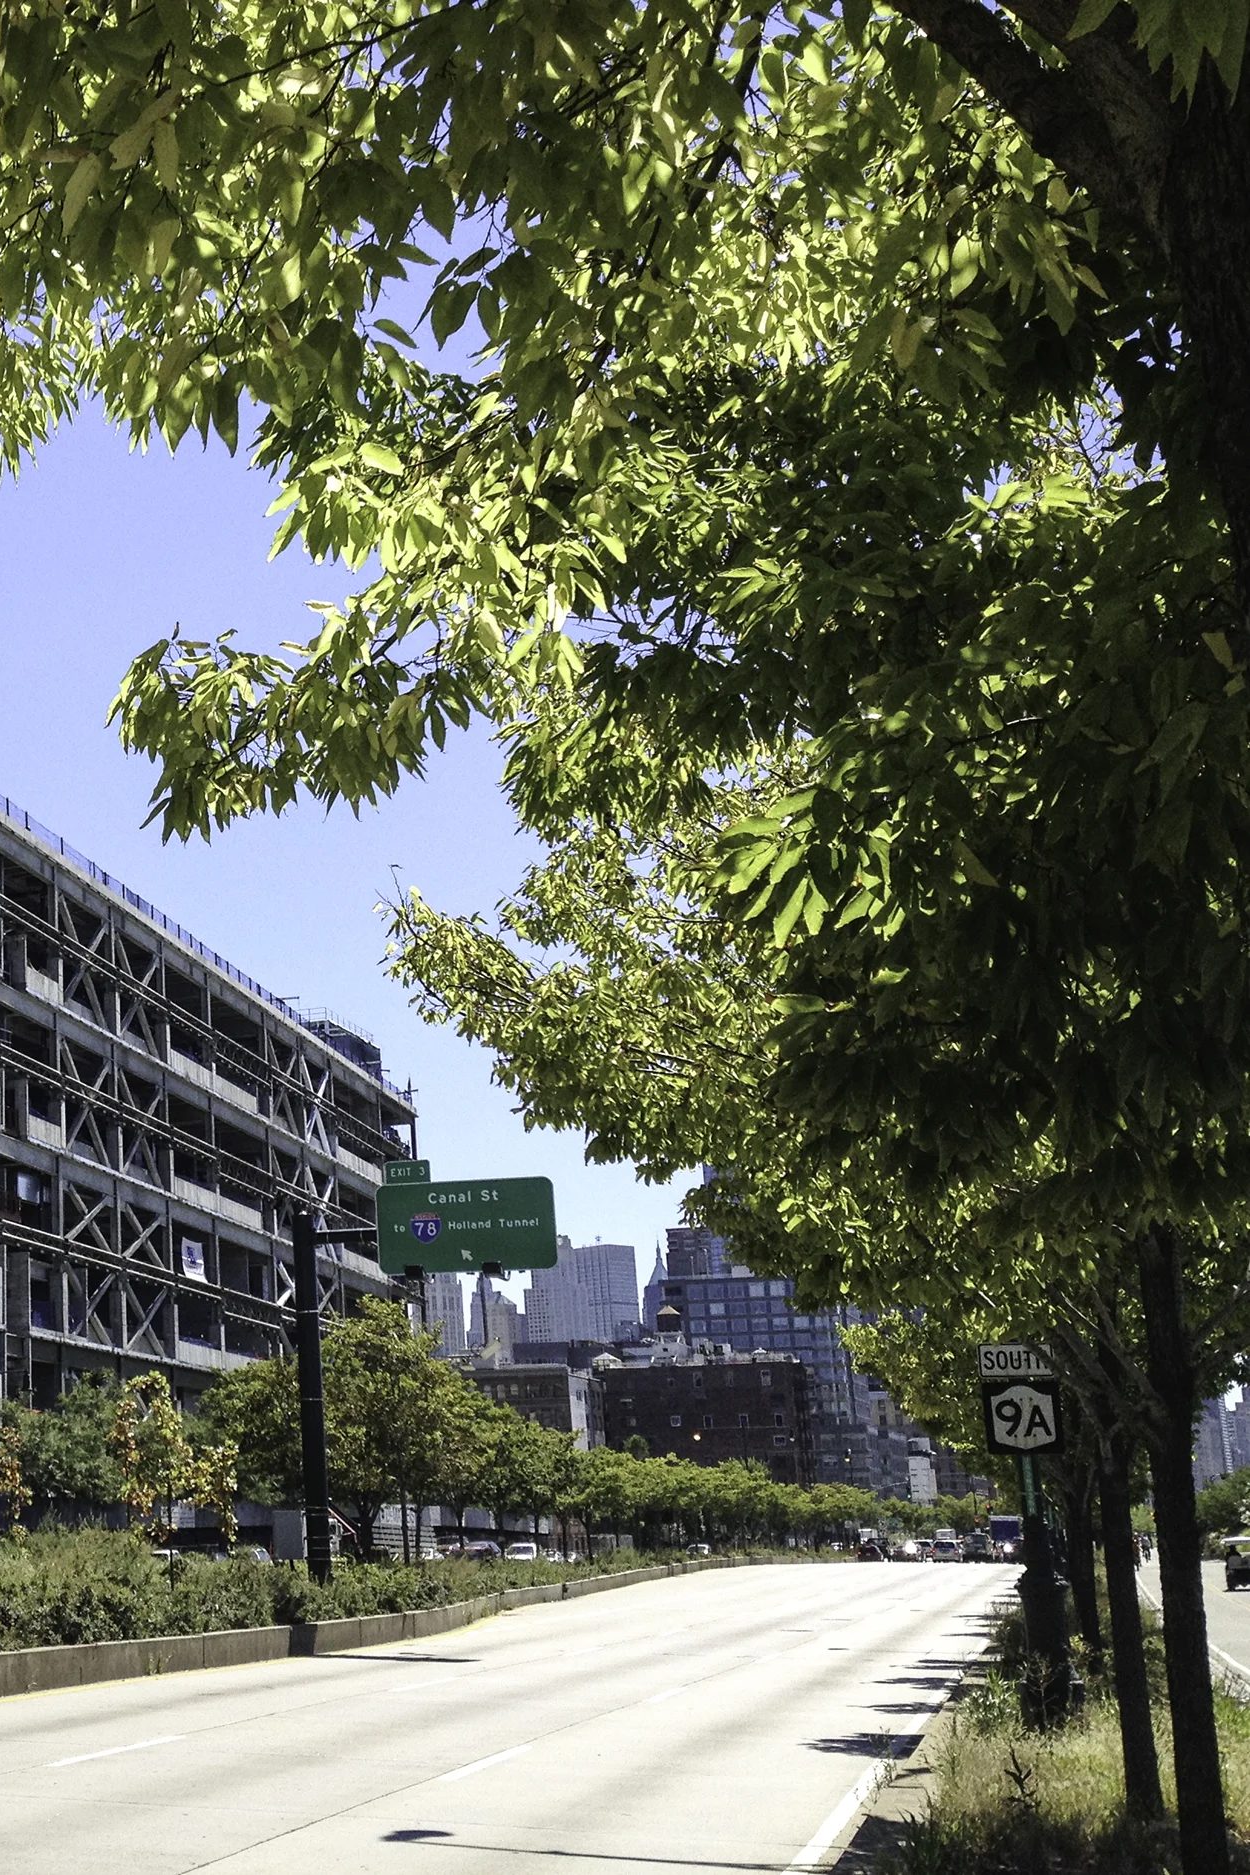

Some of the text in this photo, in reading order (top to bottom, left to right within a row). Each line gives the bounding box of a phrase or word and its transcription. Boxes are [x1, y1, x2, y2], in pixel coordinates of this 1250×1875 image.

[390, 1166, 426, 1178] EXIT 3
[428, 1189, 499, 1204] Canal St
[393, 1217, 540, 1237] to 78 Holland Tunnel
[995, 1399, 1053, 1438] 9A
